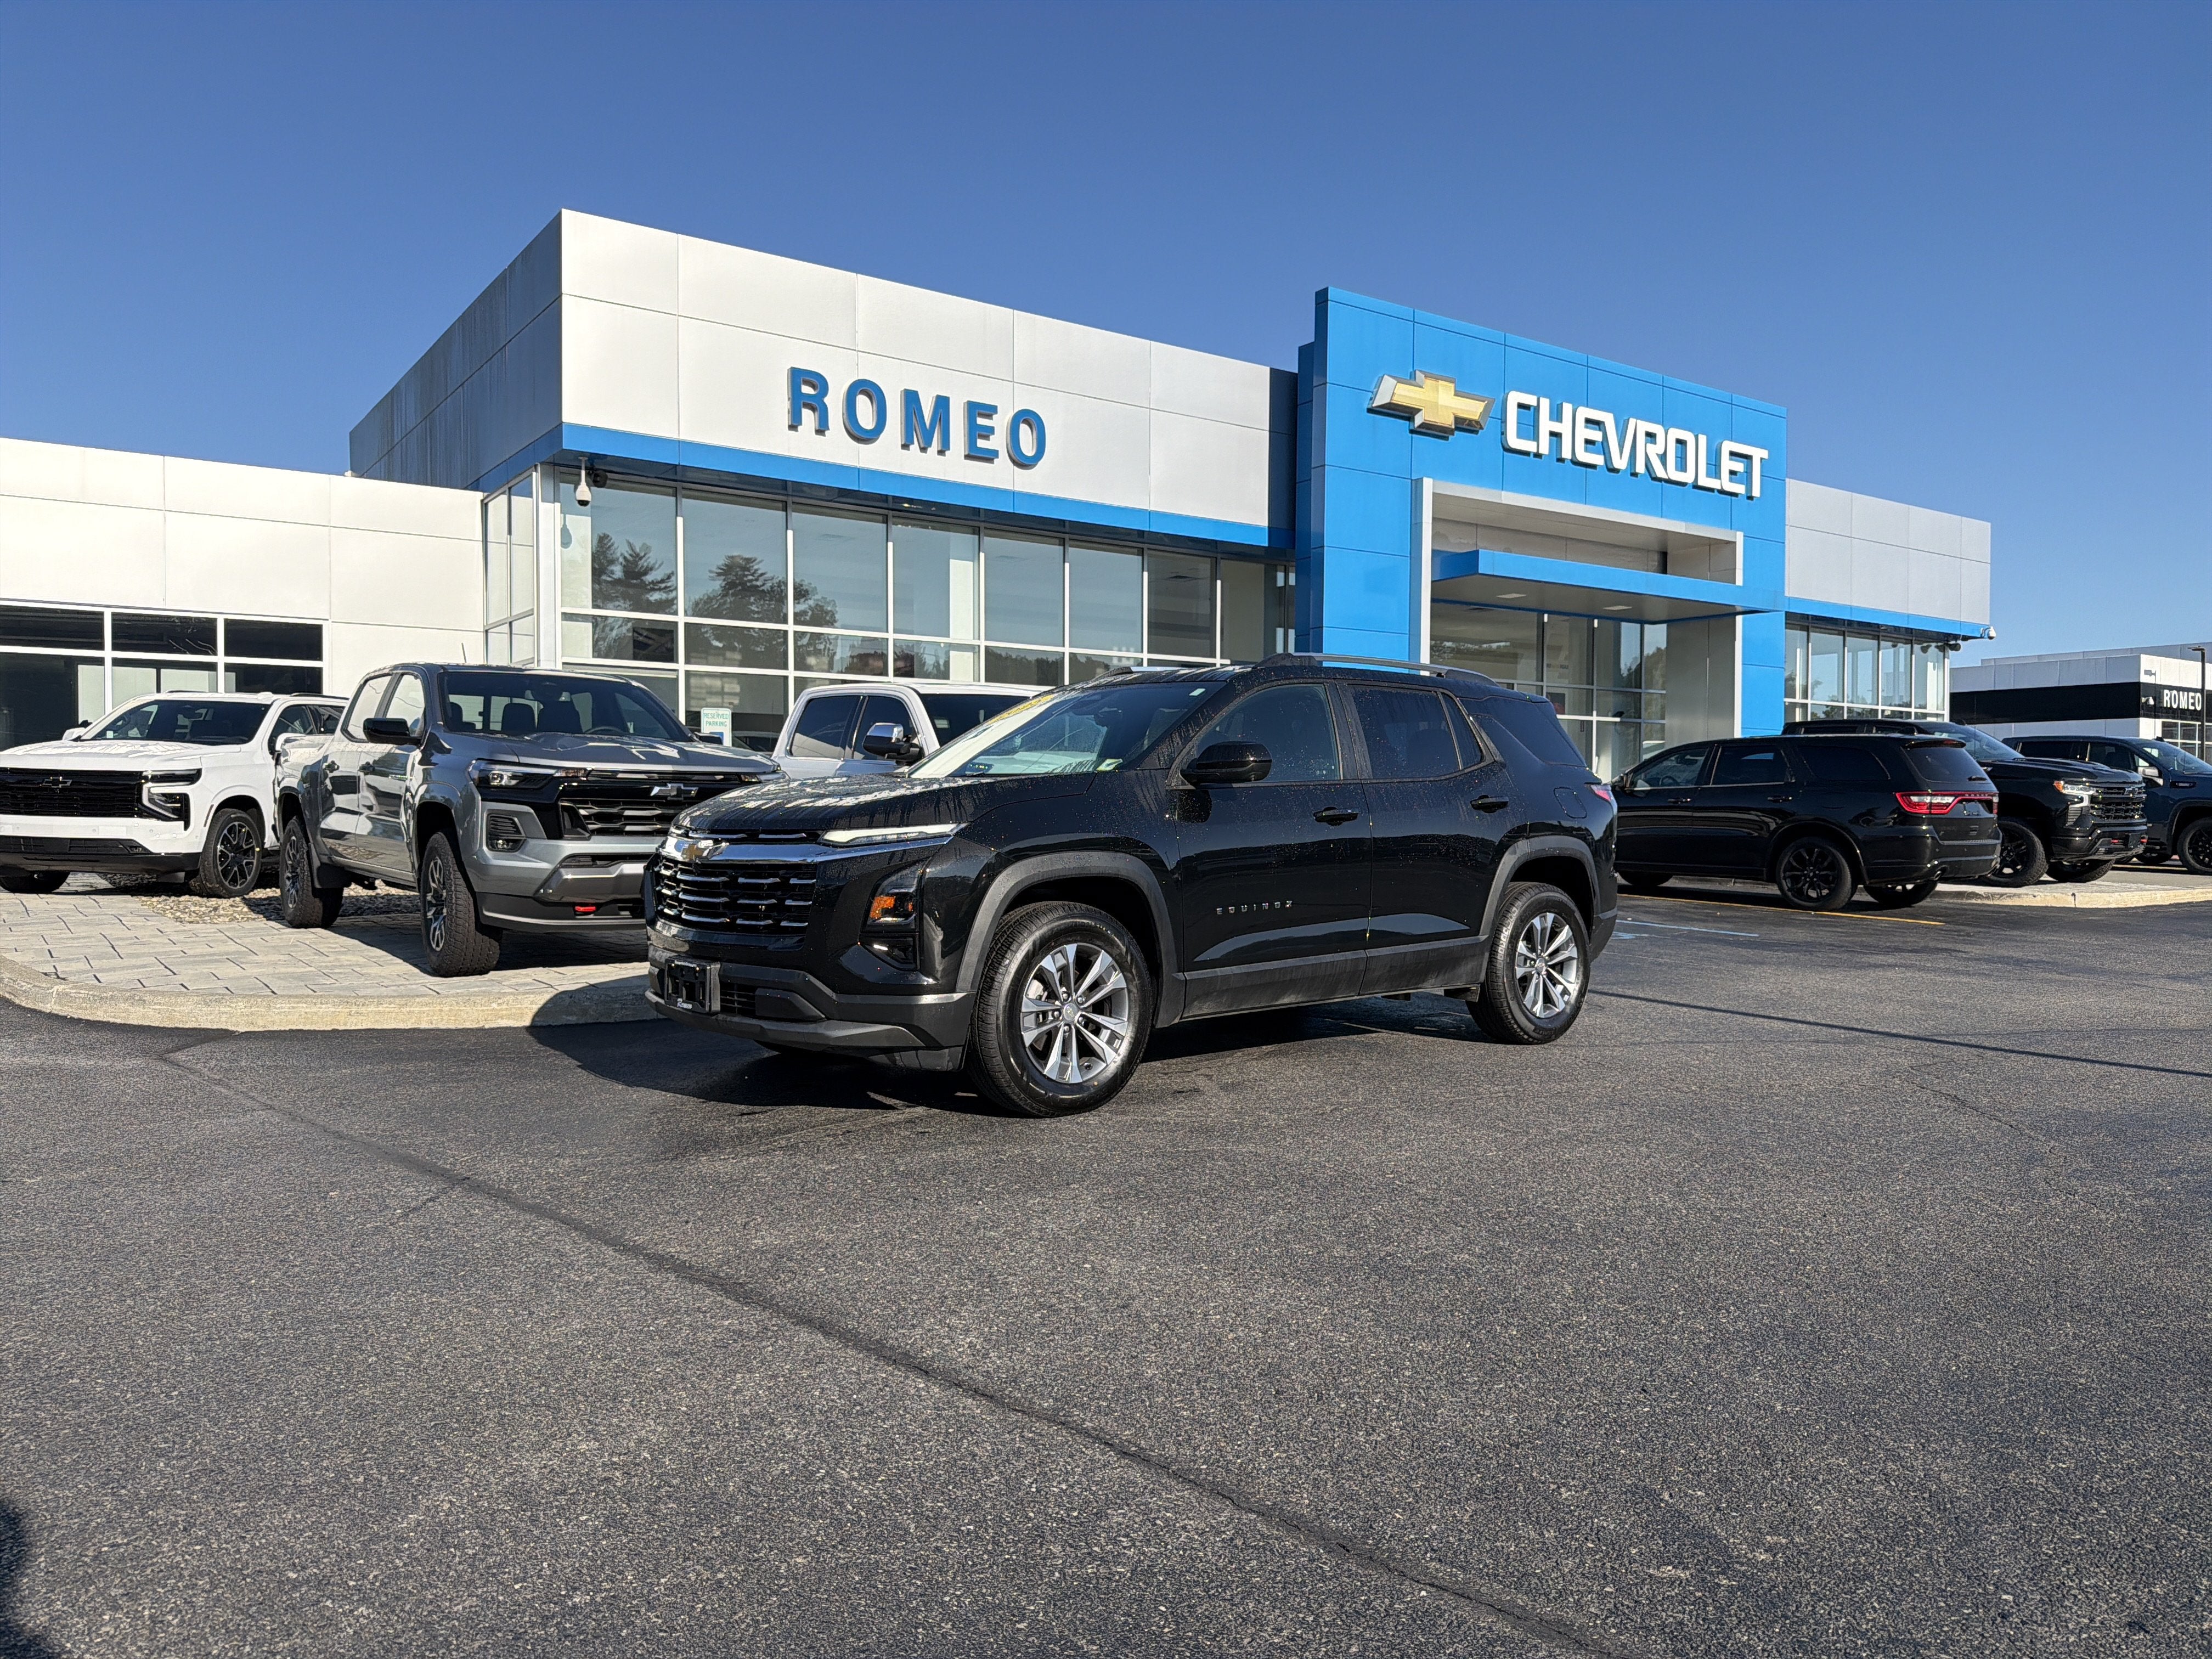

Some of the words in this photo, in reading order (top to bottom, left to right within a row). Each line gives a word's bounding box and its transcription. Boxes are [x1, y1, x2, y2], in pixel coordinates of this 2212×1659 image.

[787, 366, 1046, 467] ROMEO
[1502, 390, 1769, 498] CHEVROLET
[2164, 689, 2202, 711] ROMEO
[1216, 900, 1293, 915] EQUINOX
